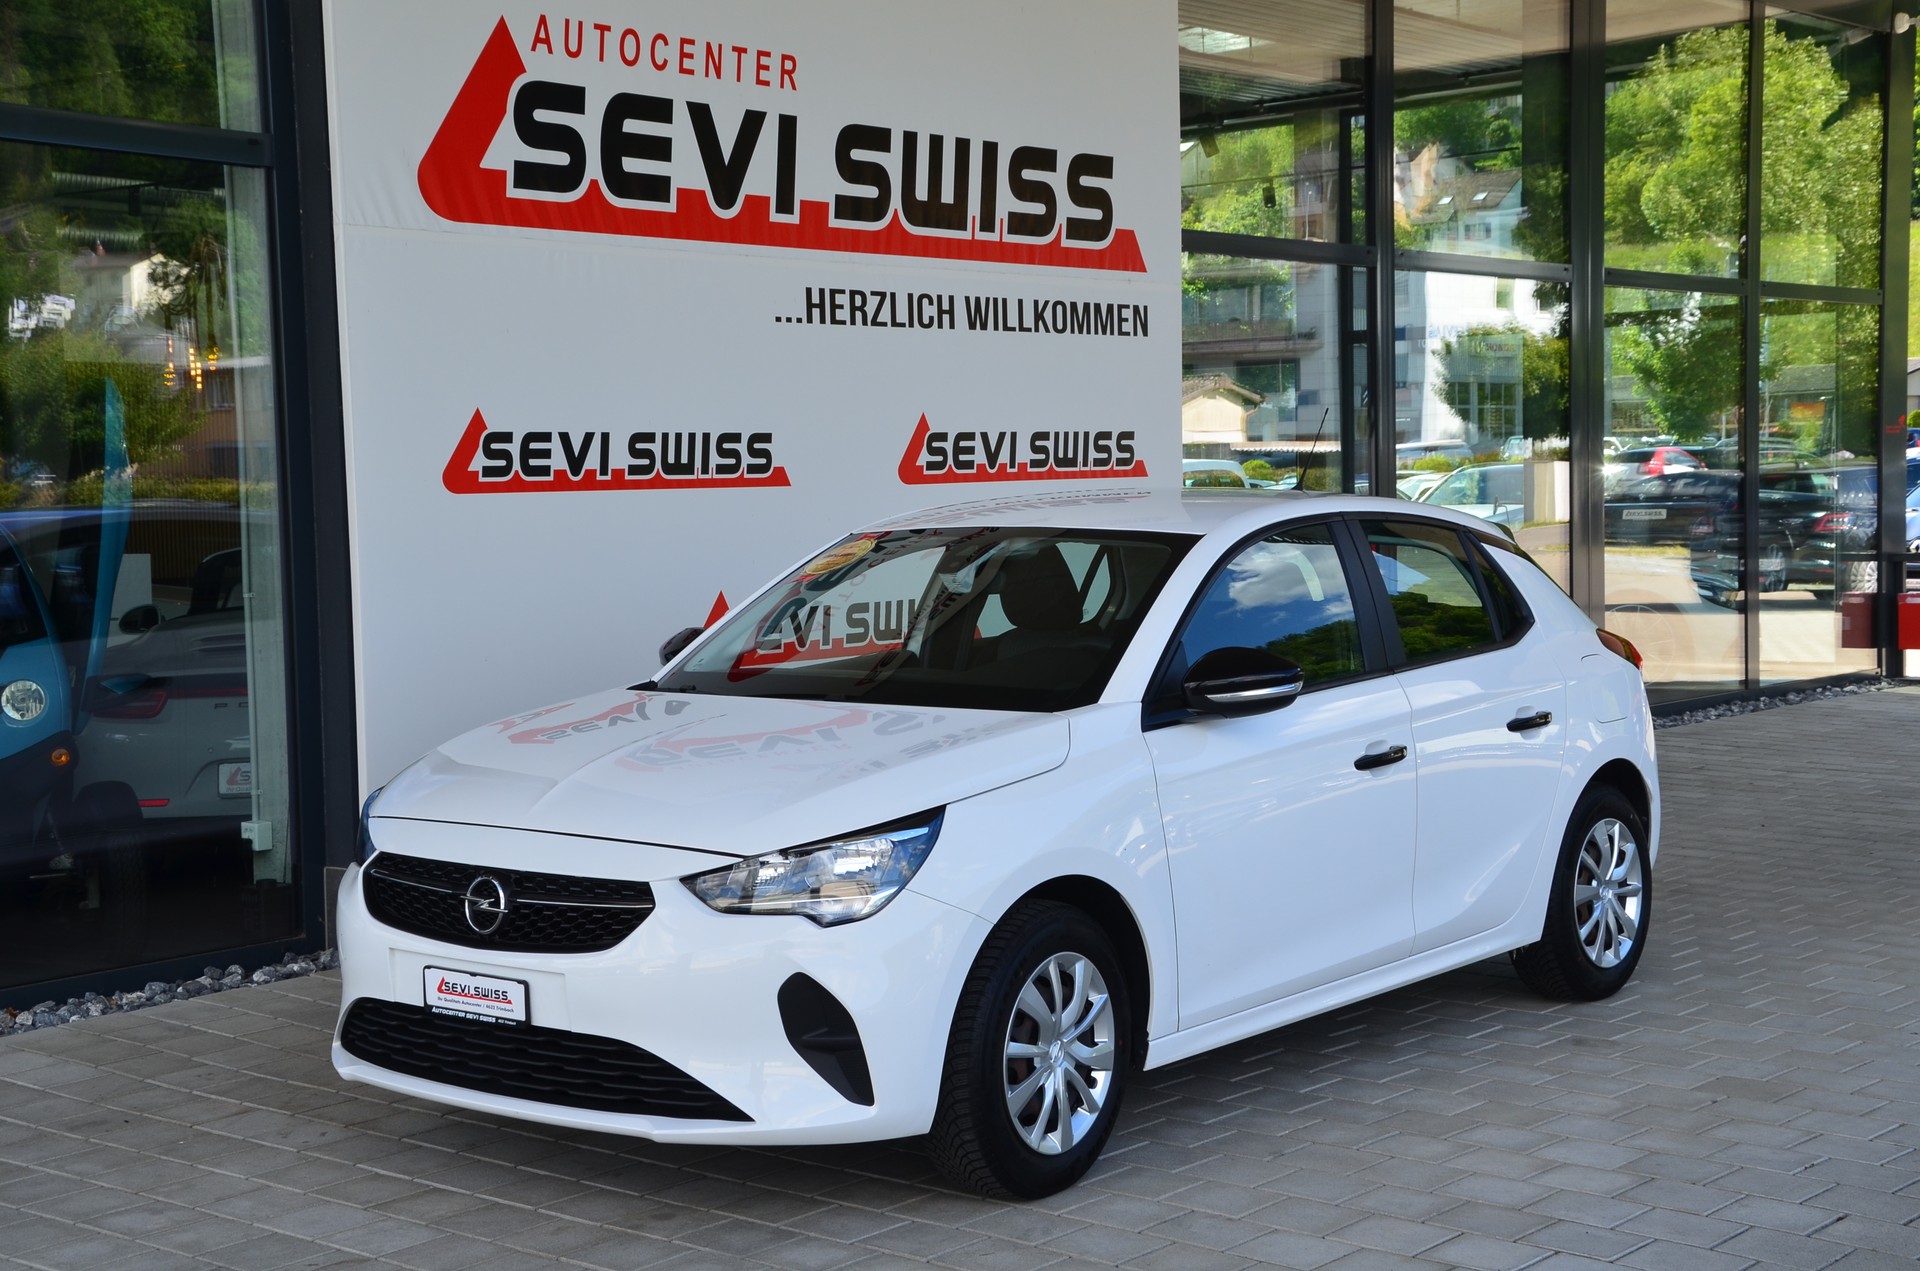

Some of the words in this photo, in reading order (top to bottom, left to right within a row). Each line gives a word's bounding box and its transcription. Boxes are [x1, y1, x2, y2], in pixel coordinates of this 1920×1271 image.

[530, 14, 798, 91] AUTOCENTER
[512, 80, 798, 216] SEVI
[833, 123, 1115, 243] SWISS
[964, 295, 1149, 337] WILLKOMMEN
[481, 431, 610, 478] SEVI
[627, 431, 773, 476] SWISS
[925, 431, 1018, 472] SEVI
[1029, 430, 1135, 469] SWISS
[443, 981, 471, 995] SEVI
[473, 986, 508, 1001] SWISS
[466, 1012, 479, 1020] SEVI
